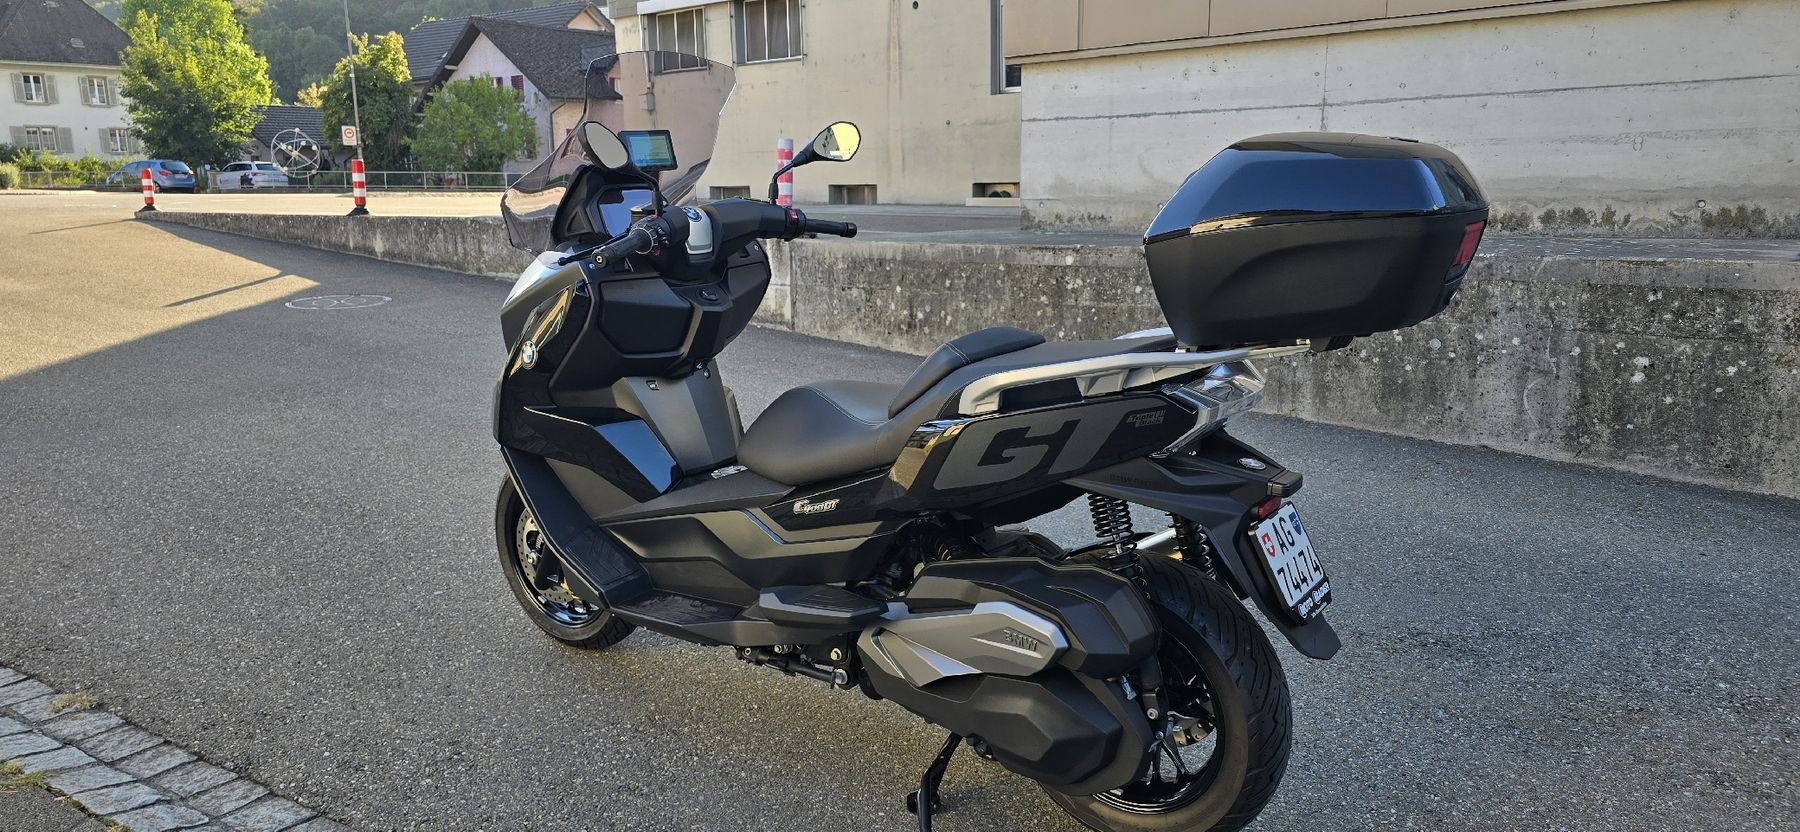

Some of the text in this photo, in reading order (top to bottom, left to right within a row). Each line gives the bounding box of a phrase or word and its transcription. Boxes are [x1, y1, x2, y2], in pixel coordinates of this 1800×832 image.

[933, 397, 1169, 490] GT
[1272, 517, 1295, 555] AG
[1277, 546, 1322, 601] 74474
[1003, 629, 1038, 652] BMW
